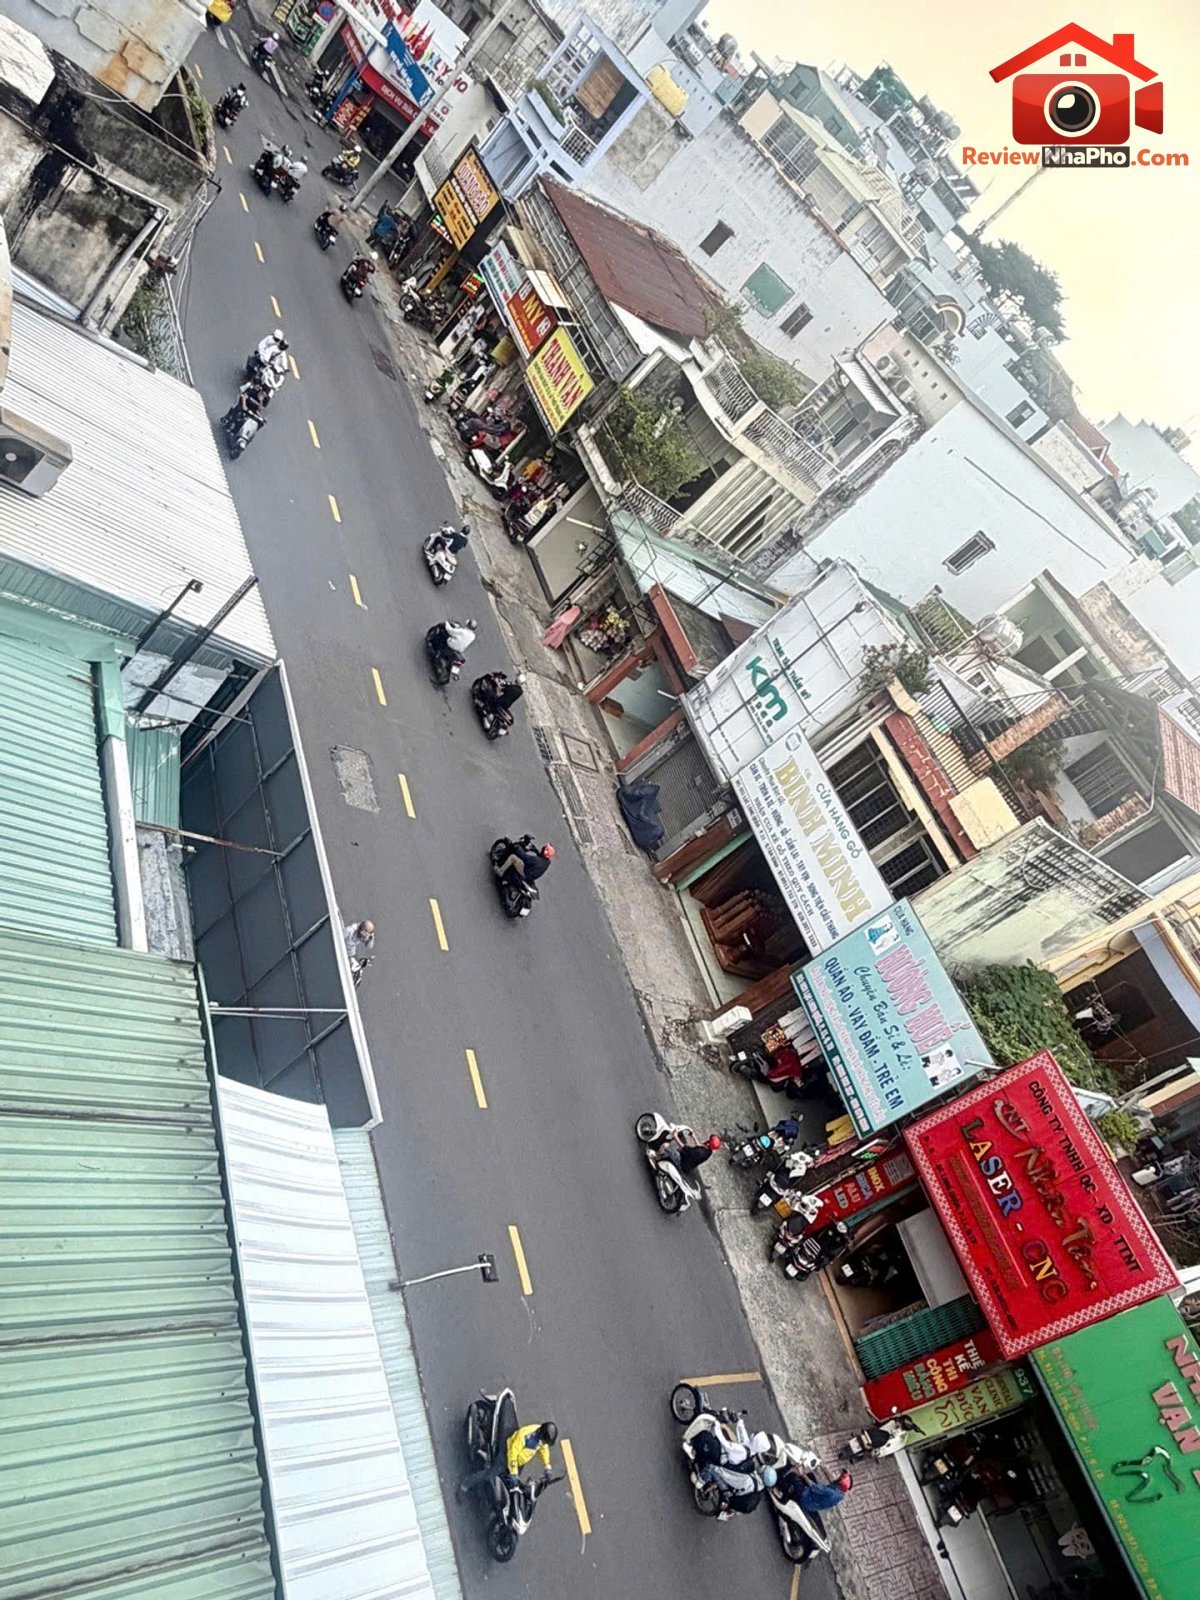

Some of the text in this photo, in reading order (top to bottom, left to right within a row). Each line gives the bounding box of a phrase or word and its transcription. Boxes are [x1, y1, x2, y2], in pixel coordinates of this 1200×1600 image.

[542, 338, 571, 387] THANH
[816, 783, 863, 858] CỬA HÀNG GỖ
[774, 756, 834, 836] BÌNH
[811, 830, 870, 921] MINH
[782, 856, 794, 876] THEO
[838, 986, 854, 1002] ÁO
[854, 966, 876, 1001] Chuyên
[873, 1000, 888, 1024] Bán
[891, 1041, 906, 1050] &
[849, 1007, 868, 1030] VÁY
[874, 1063, 898, 1088] TRẺ
[885, 1088, 904, 1109] EM
[868, 1167, 884, 1192] INOX
[1029, 1081, 1054, 1115] CÔNG
[1048, 1116, 1066, 1132] TY
[1060, 1135, 1086, 1172] TNHH
[1080, 1174, 1098, 1193] QC
[1096, 1205, 1114, 1224] XD
[1114, 1235, 1143, 1271] TTNT
[845, 1182, 861, 1203] ALU
[961, 1119, 1025, 1215] LASER
[1019, 1238, 1070, 1305] CNC
[927, 1358, 948, 1392] CÔNG
[942, 1358, 958, 1381] THI
[1015, 1369, 1033, 1393] 937
[1165, 1335, 1200, 1403] NH
[954, 1391, 974, 1422] ĐỨC
[971, 1385, 990, 1414] VẠN
[1150, 1383, 1200, 1452] VẠN
